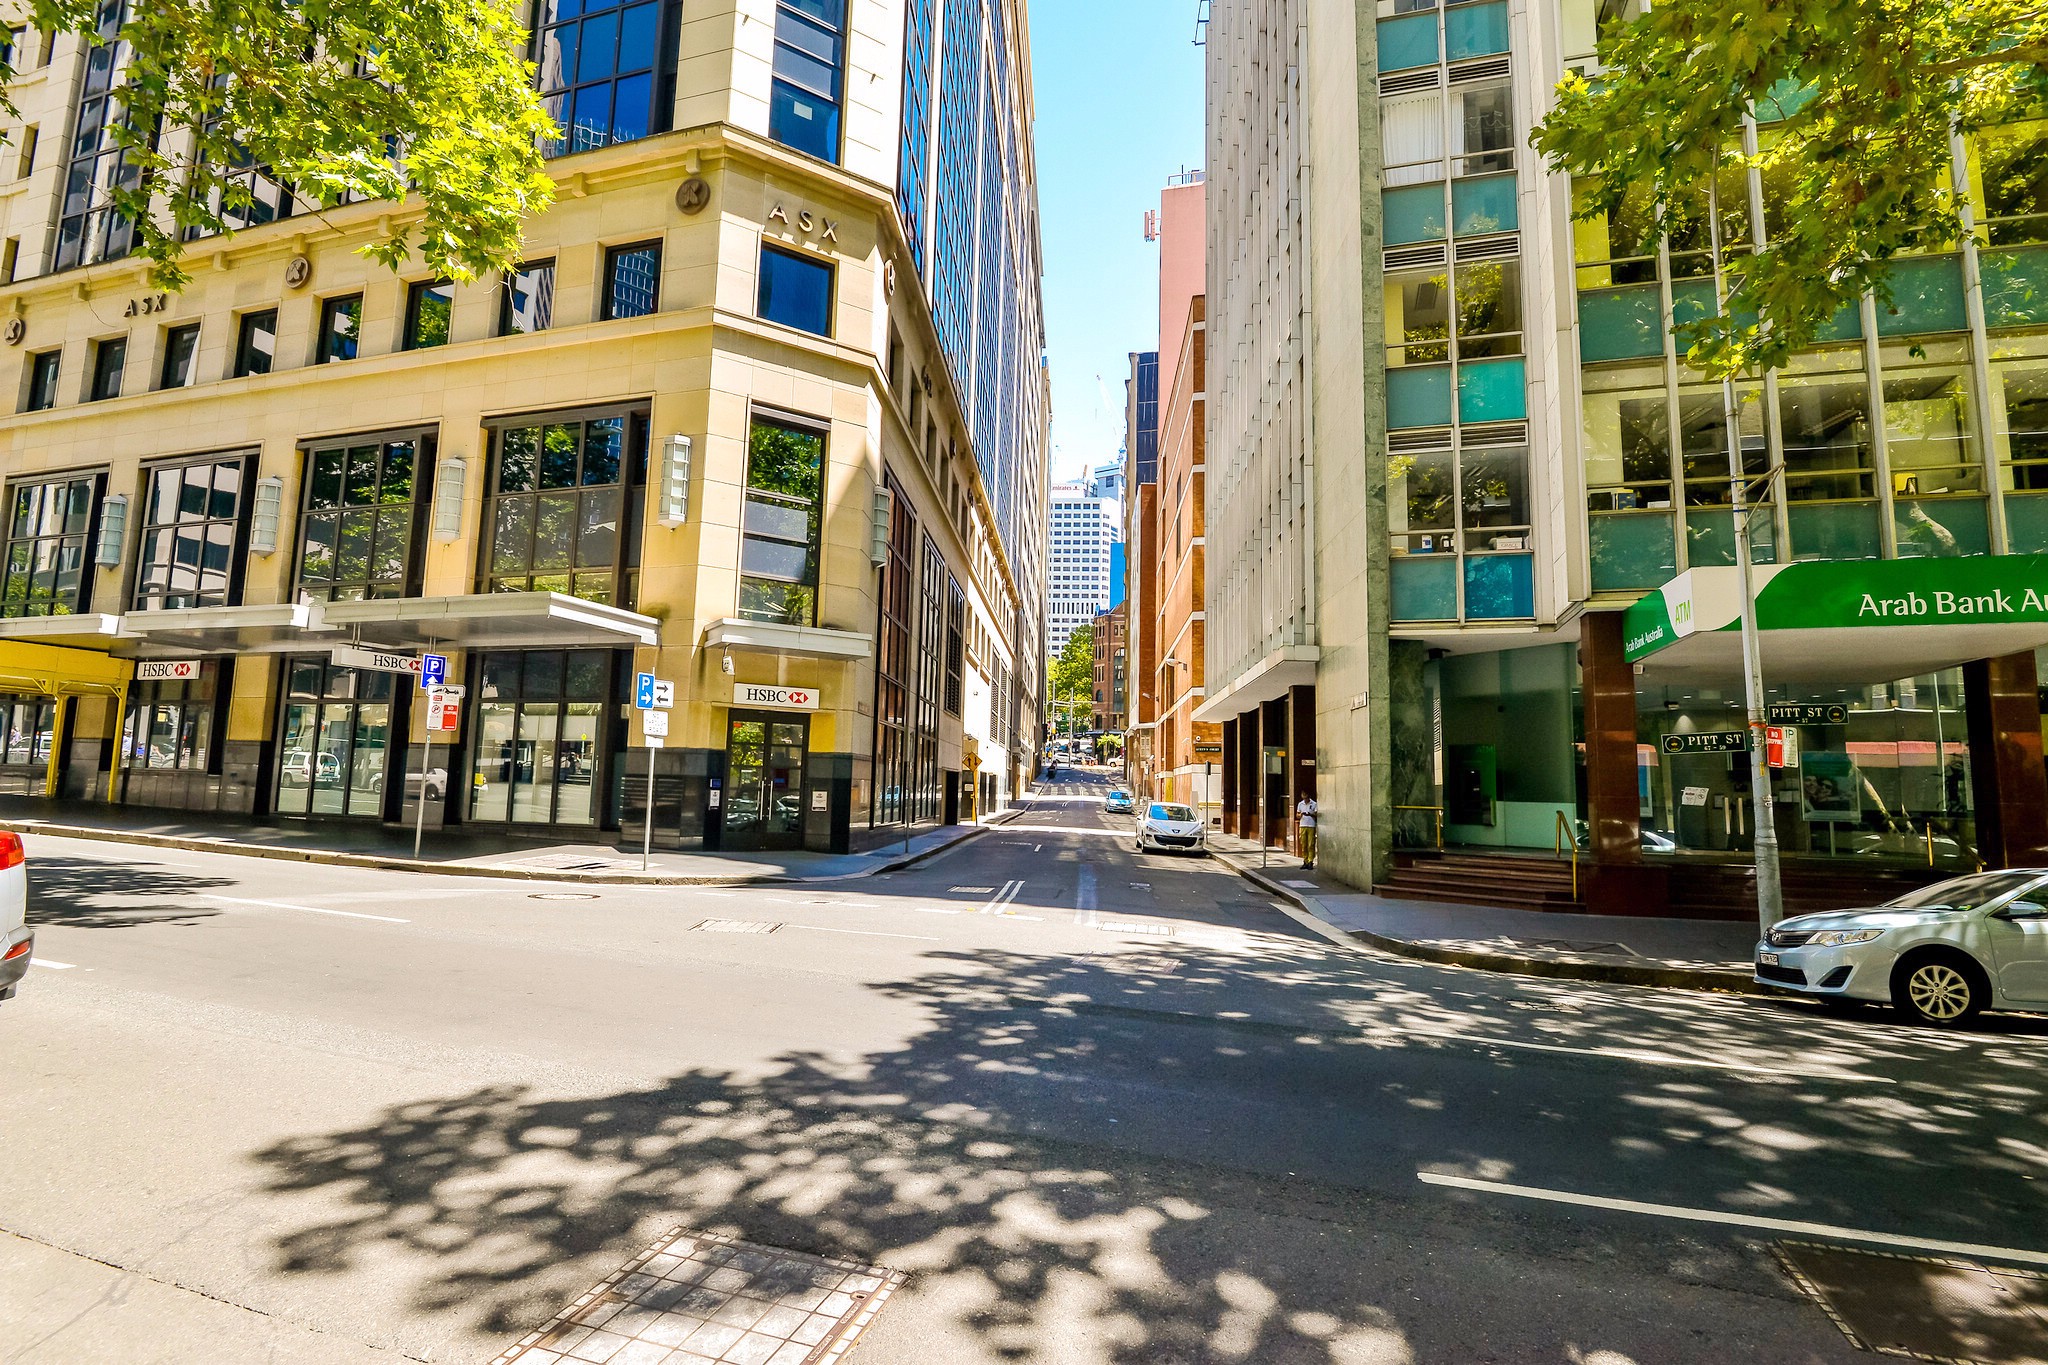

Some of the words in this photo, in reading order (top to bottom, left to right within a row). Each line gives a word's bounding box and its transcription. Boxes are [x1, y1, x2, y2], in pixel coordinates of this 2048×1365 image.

[768, 202, 838, 243] ASX
[123, 293, 167, 317] ASX
[1858, 591, 1928, 617] Arab
[1932, 588, 2015, 615] Bank
[1675, 600, 1691, 625] ATM
[1634, 634, 1645, 650] Bank
[1644, 625, 1663, 644] Australia
[142, 663, 174, 677] HSBC
[373, 654, 408, 670] HSBC
[430, 660, 440, 672] P
[641, 676, 651, 691] P
[746, 687, 787, 703] HSBC
[1771, 707, 1801, 718] PITT
[1807, 707, 1823, 718] ST
[1687, 735, 1719, 746] PITT
[1725, 734, 1742, 744] ST
[1785, 729, 1794, 738] 1P
